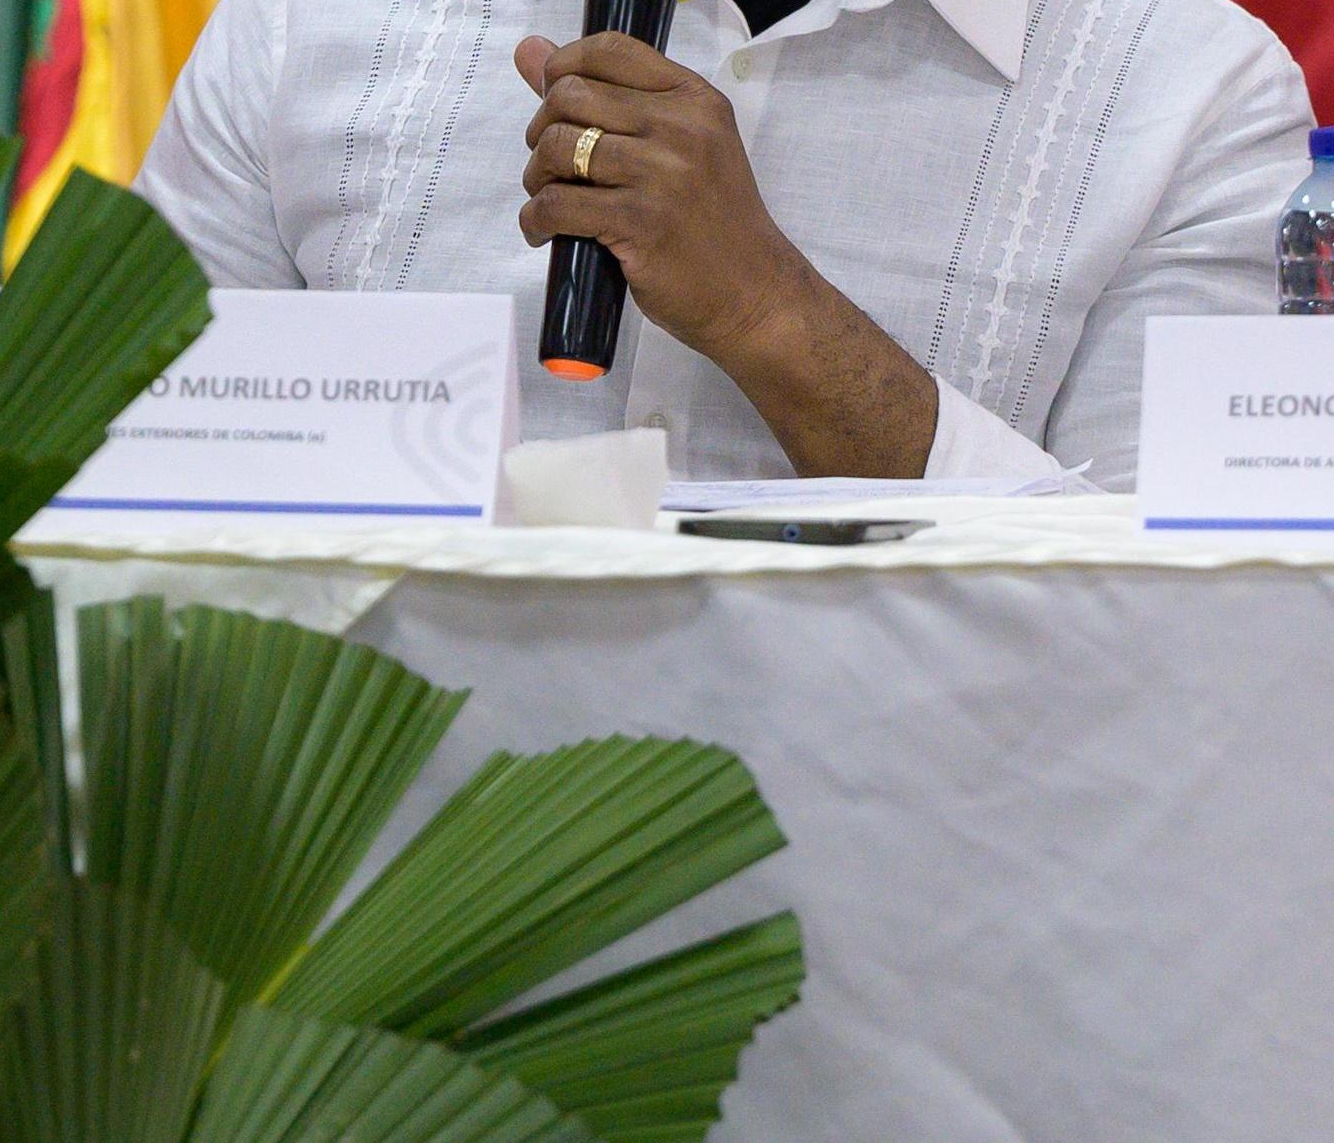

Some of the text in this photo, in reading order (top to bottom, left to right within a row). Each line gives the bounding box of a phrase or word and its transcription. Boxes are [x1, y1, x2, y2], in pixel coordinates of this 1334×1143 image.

[147, 376, 451, 403] O MURILLO URRUTIA
[129, 428, 209, 440] EXTERIORES
[211, 429, 229, 441] DE
[1224, 456, 1300, 468] DIRECTORA
[1303, 456, 1321, 468] DE
